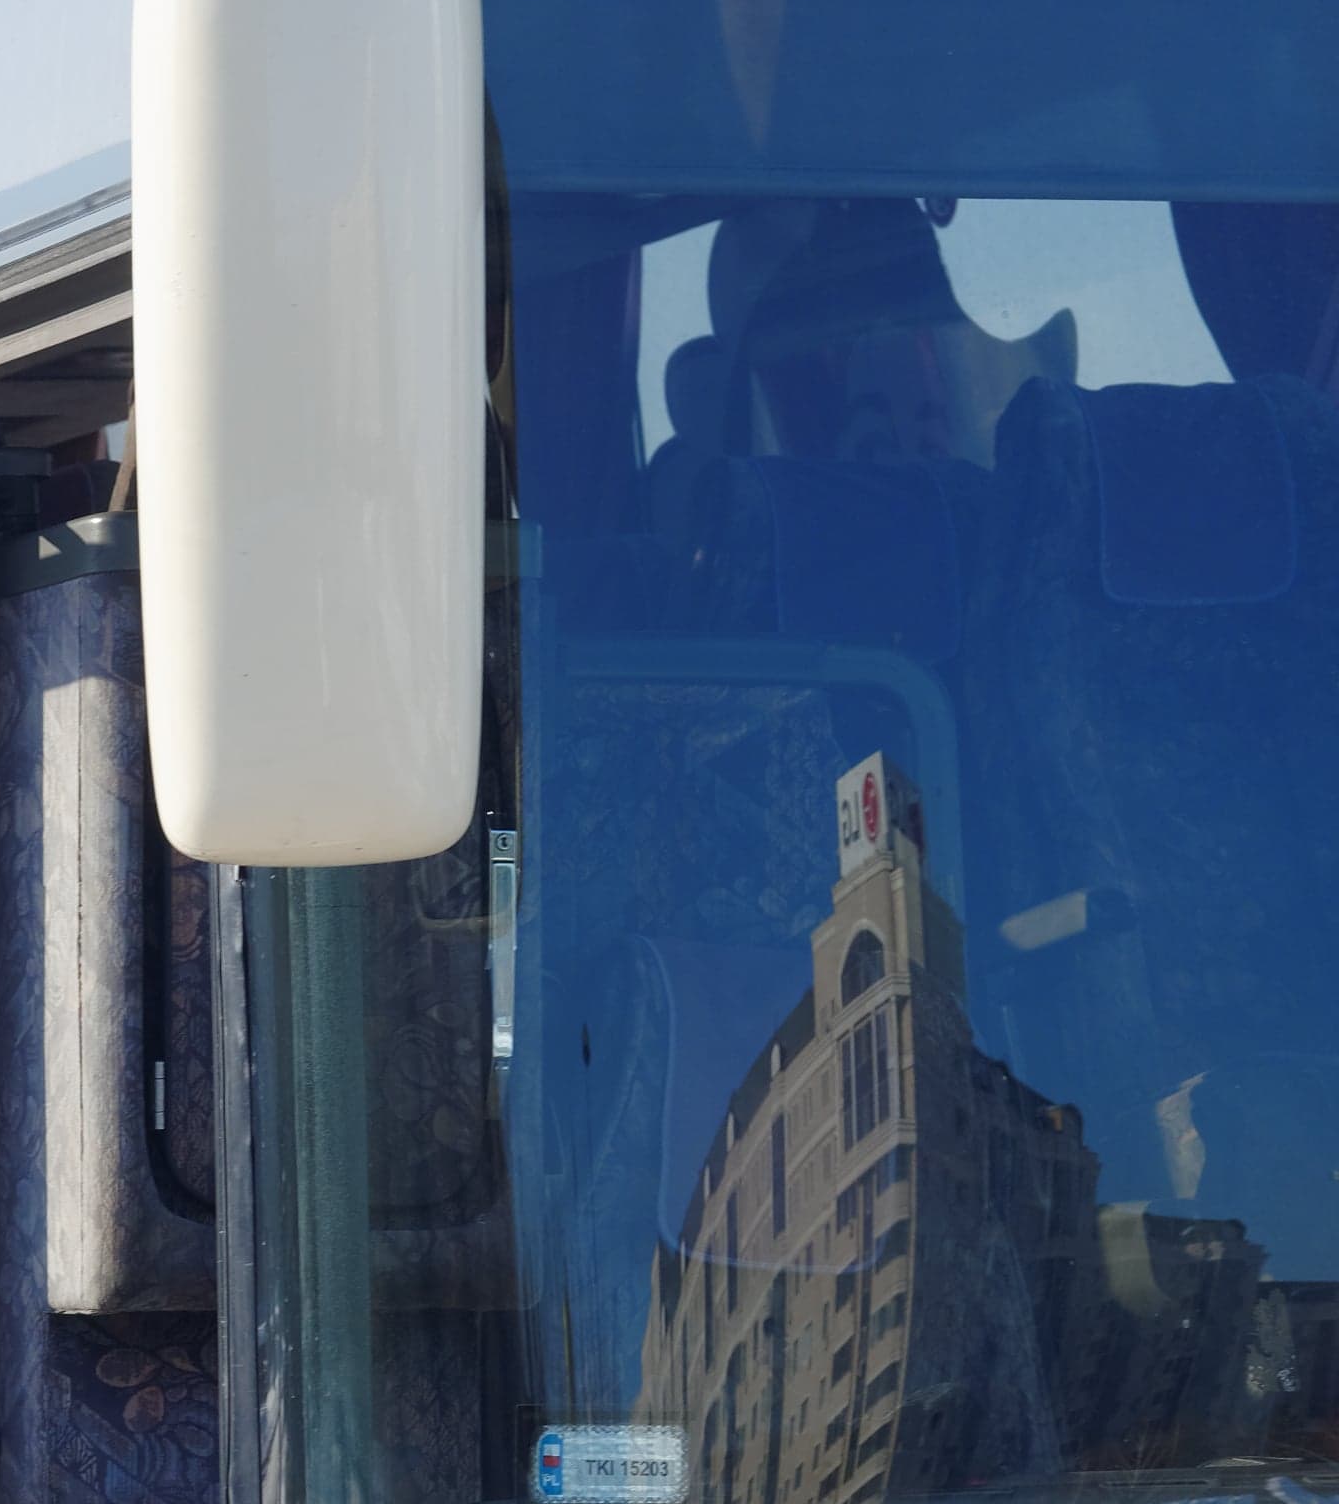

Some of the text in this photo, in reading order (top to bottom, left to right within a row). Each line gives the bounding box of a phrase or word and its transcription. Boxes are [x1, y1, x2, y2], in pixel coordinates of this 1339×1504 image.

[586, 1459, 669, 1477] TKI 15203
[542, 1474, 560, 1487] PL
